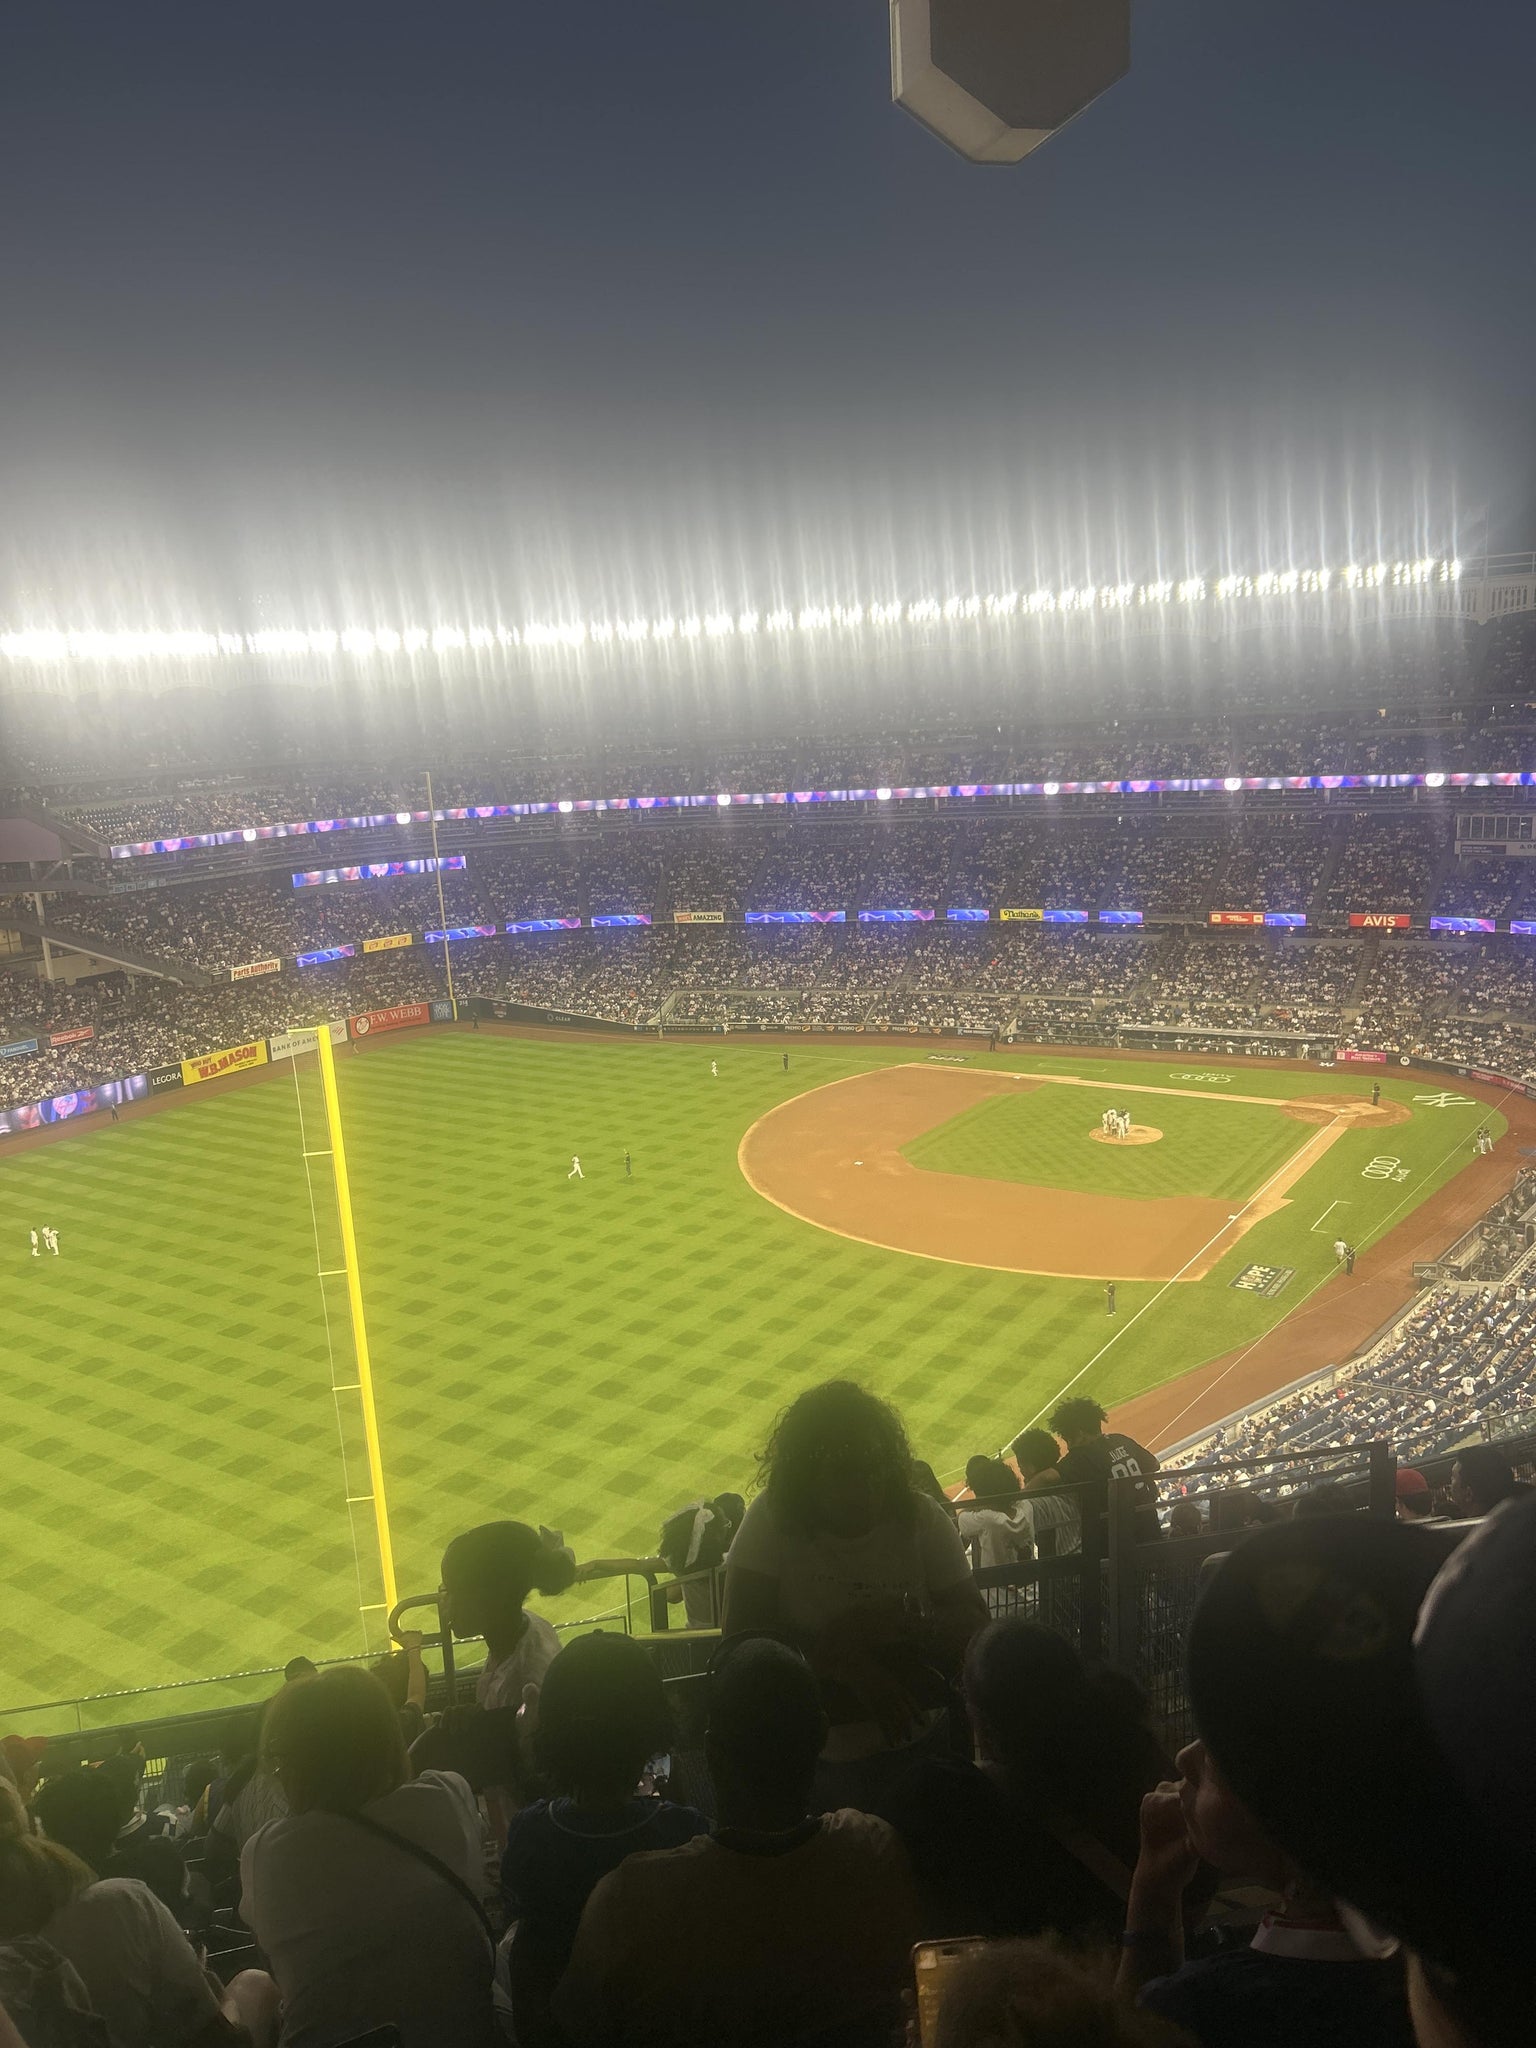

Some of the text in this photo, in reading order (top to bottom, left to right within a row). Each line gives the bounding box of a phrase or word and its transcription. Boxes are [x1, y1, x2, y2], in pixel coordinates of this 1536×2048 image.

[1363, 916, 1396, 926] AVIS
[233, 961, 278, 977] Parts Authority
[389, 1006, 422, 1019] WEBB
[272, 1043, 291, 1053] BANK
[292, 1040, 300, 1048] OF
[152, 1071, 183, 1086] LEGORA
